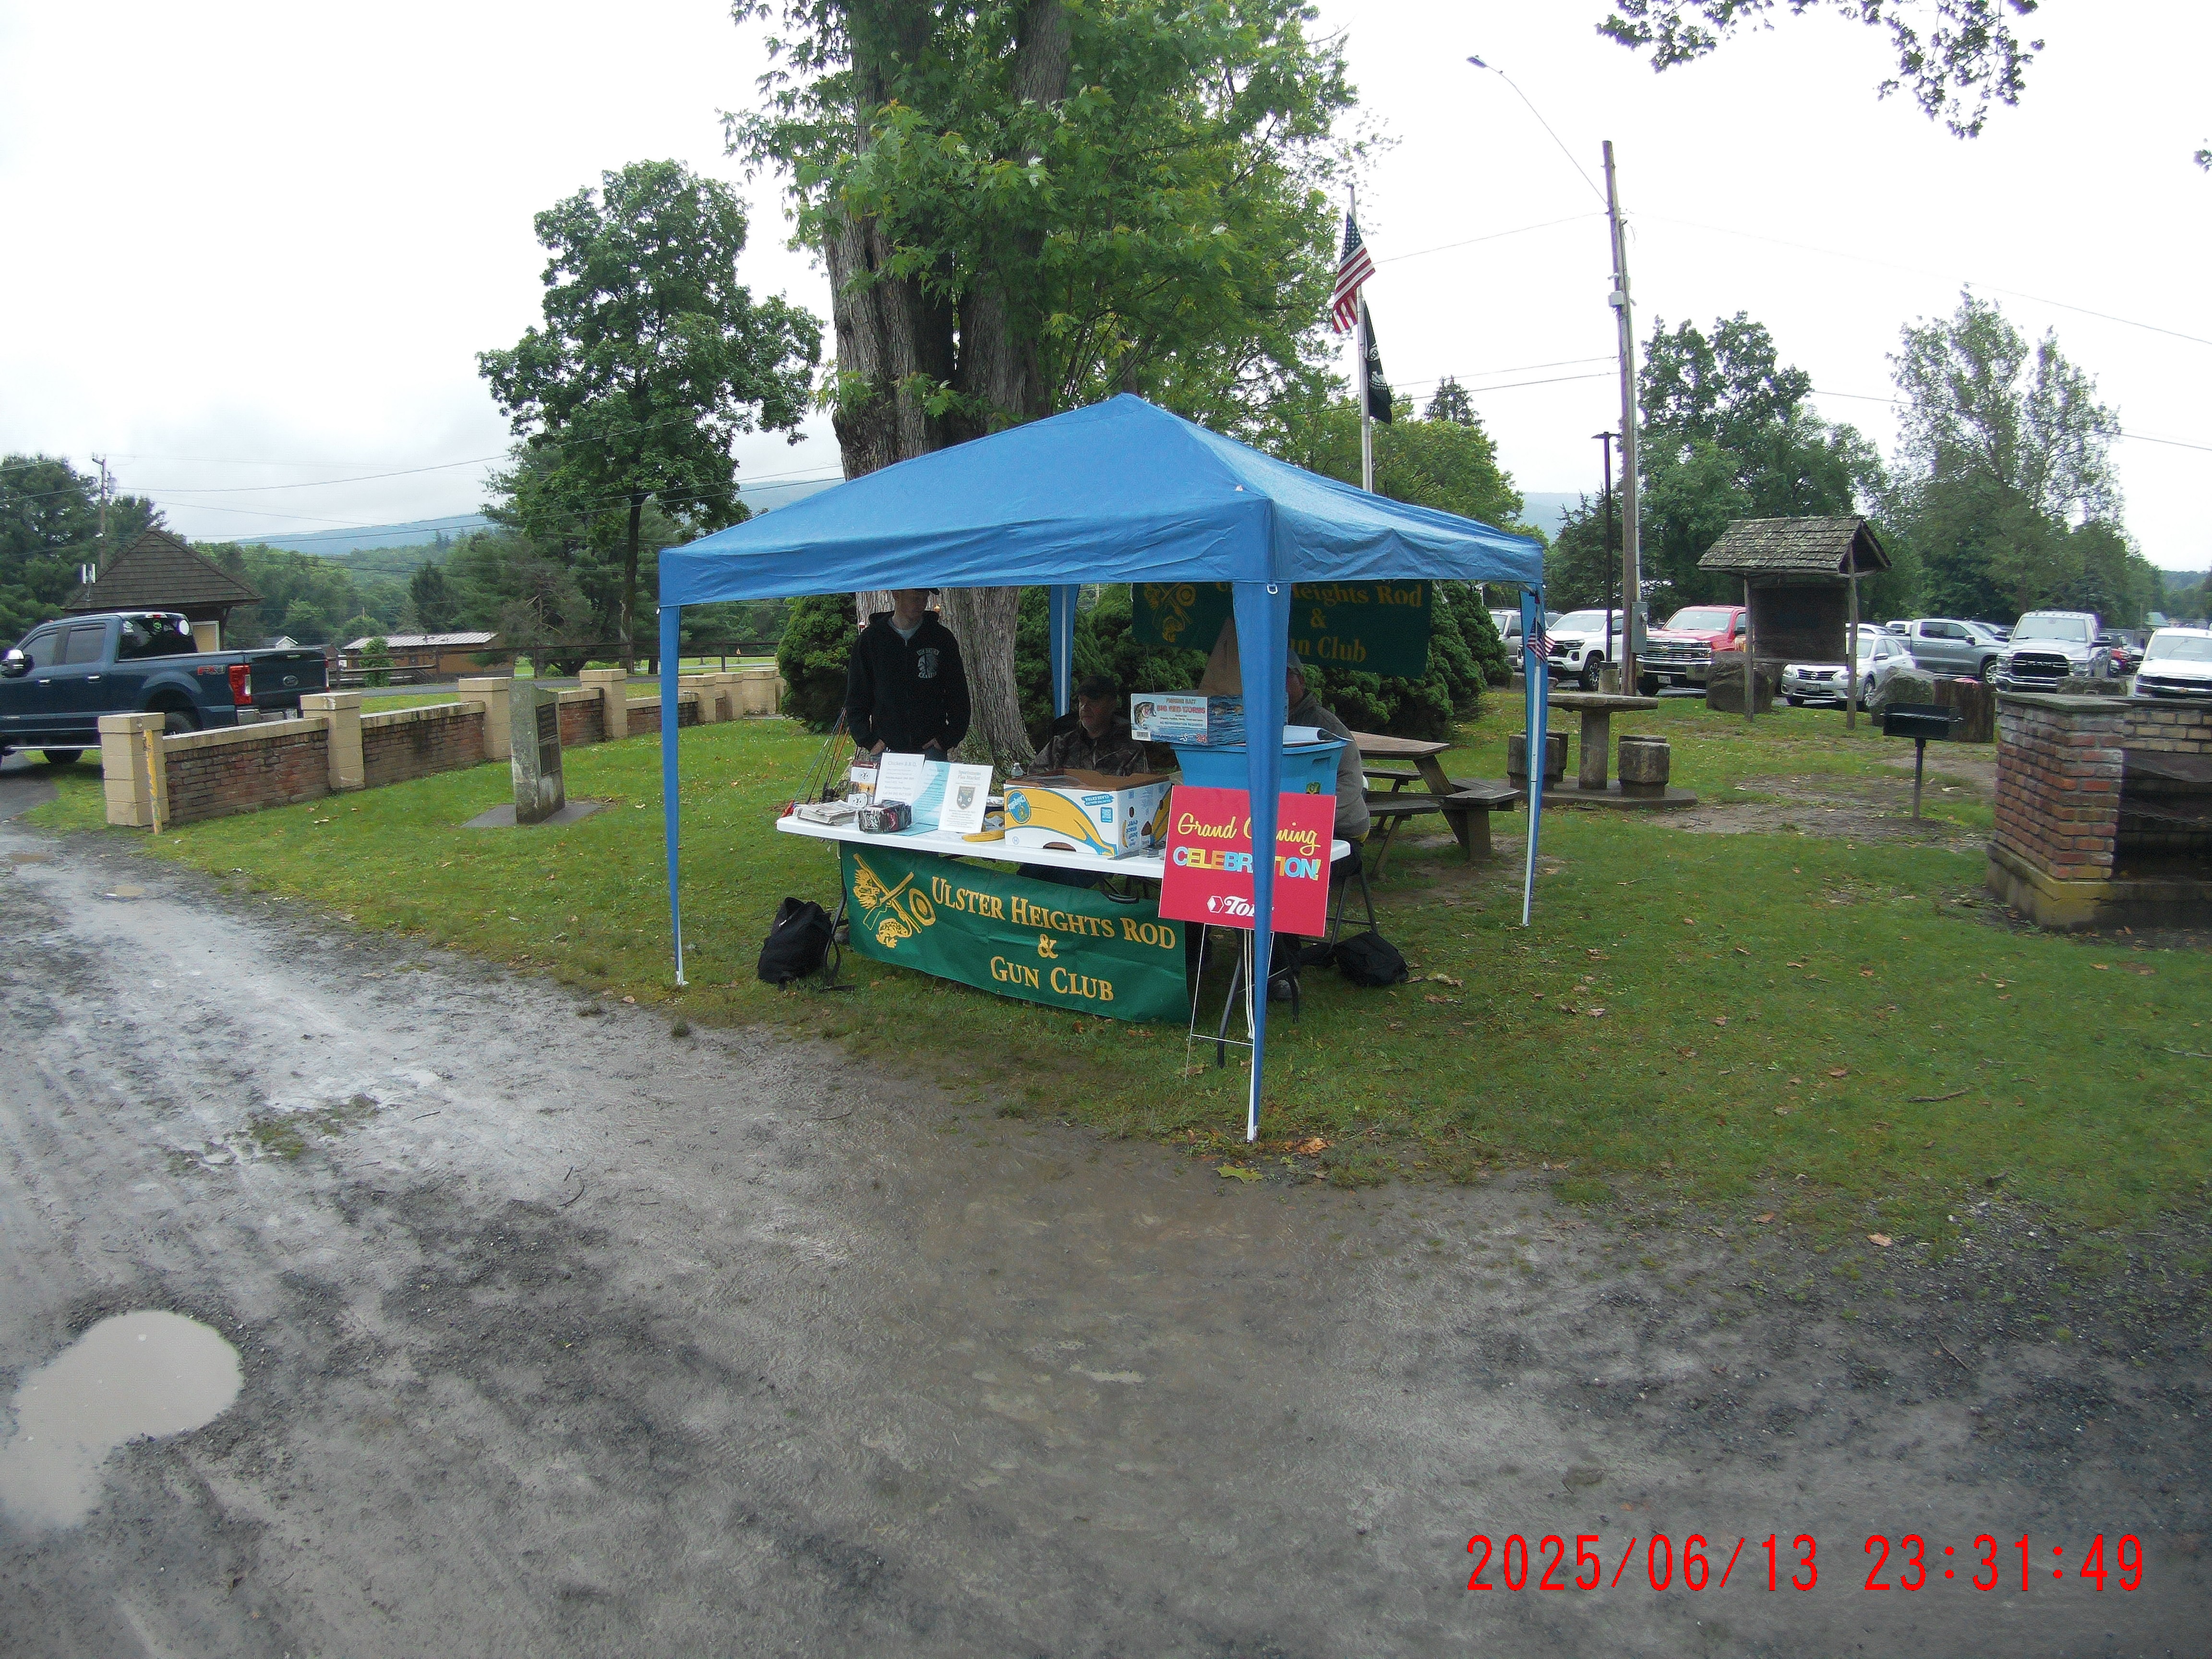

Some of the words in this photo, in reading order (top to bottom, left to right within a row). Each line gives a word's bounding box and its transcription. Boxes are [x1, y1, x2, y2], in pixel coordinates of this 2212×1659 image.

[1376, 584, 1422, 607] Rod
[1310, 608, 1327, 628] &
[1317, 635, 1367, 663] Club
[1197, 733, 1207, 744] 24
[1177, 813, 1238, 839] Grand
[1243, 816, 1321, 856] ning
[1173, 846, 1322, 881] CELEBRION!
[931, 876, 1006, 920] ULSTER
[1010, 896, 1115, 938] HEIGHTS
[1119, 917, 1177, 950] ROD
[1037, 934, 1059, 959] &
[991, 956, 1040, 989] GUN
[1050, 967, 1115, 1001] CLUB
